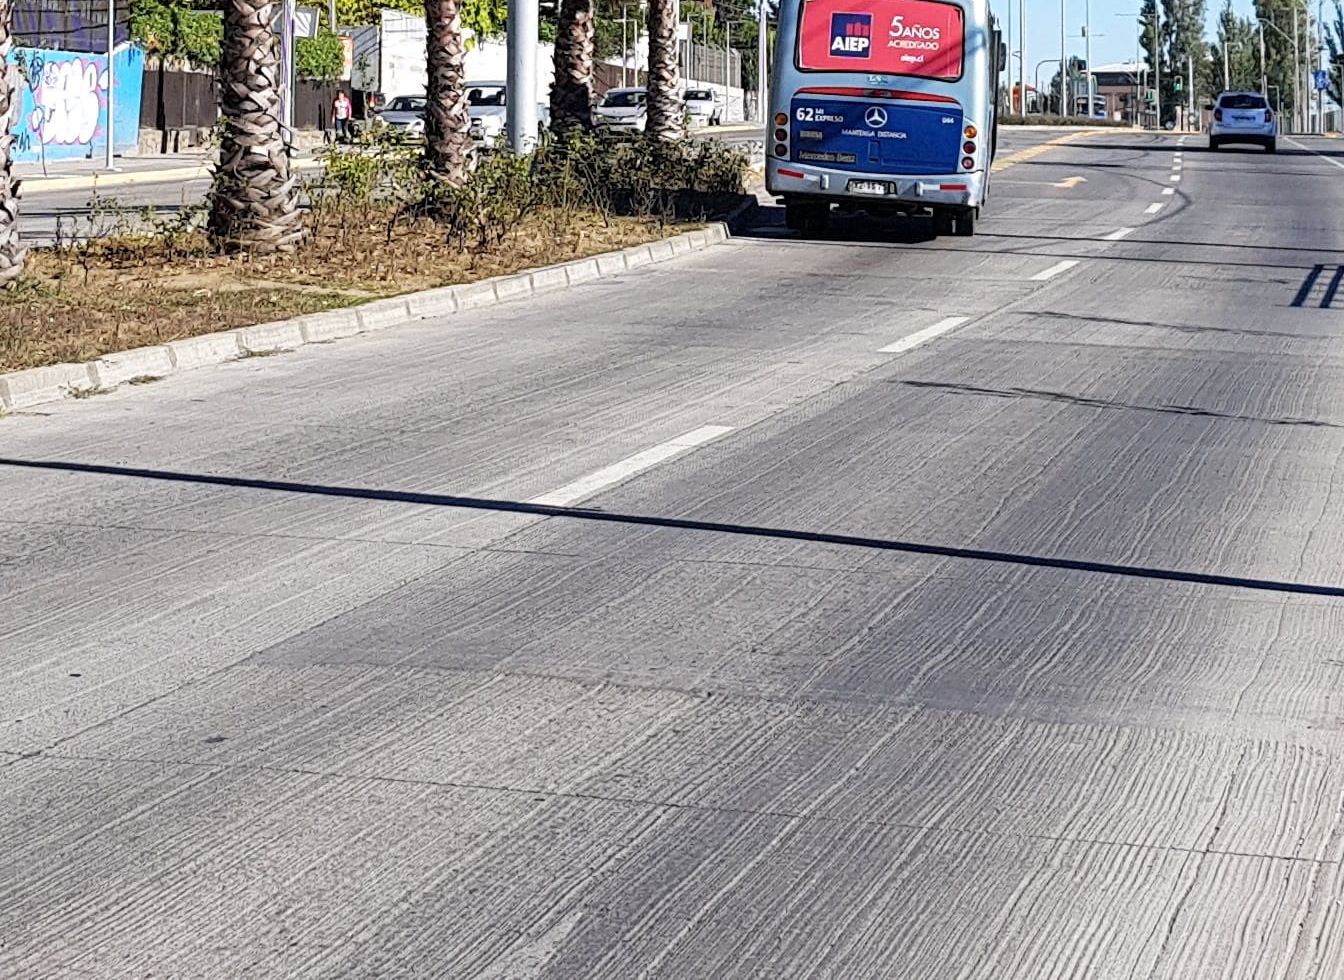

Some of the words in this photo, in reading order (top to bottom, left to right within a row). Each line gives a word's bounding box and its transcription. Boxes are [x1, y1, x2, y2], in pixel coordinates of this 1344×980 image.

[889, 16, 904, 37] 5
[903, 25, 940, 39] AÑOS
[831, 36, 870, 52] AIEP
[796, 108, 814, 122] 62
